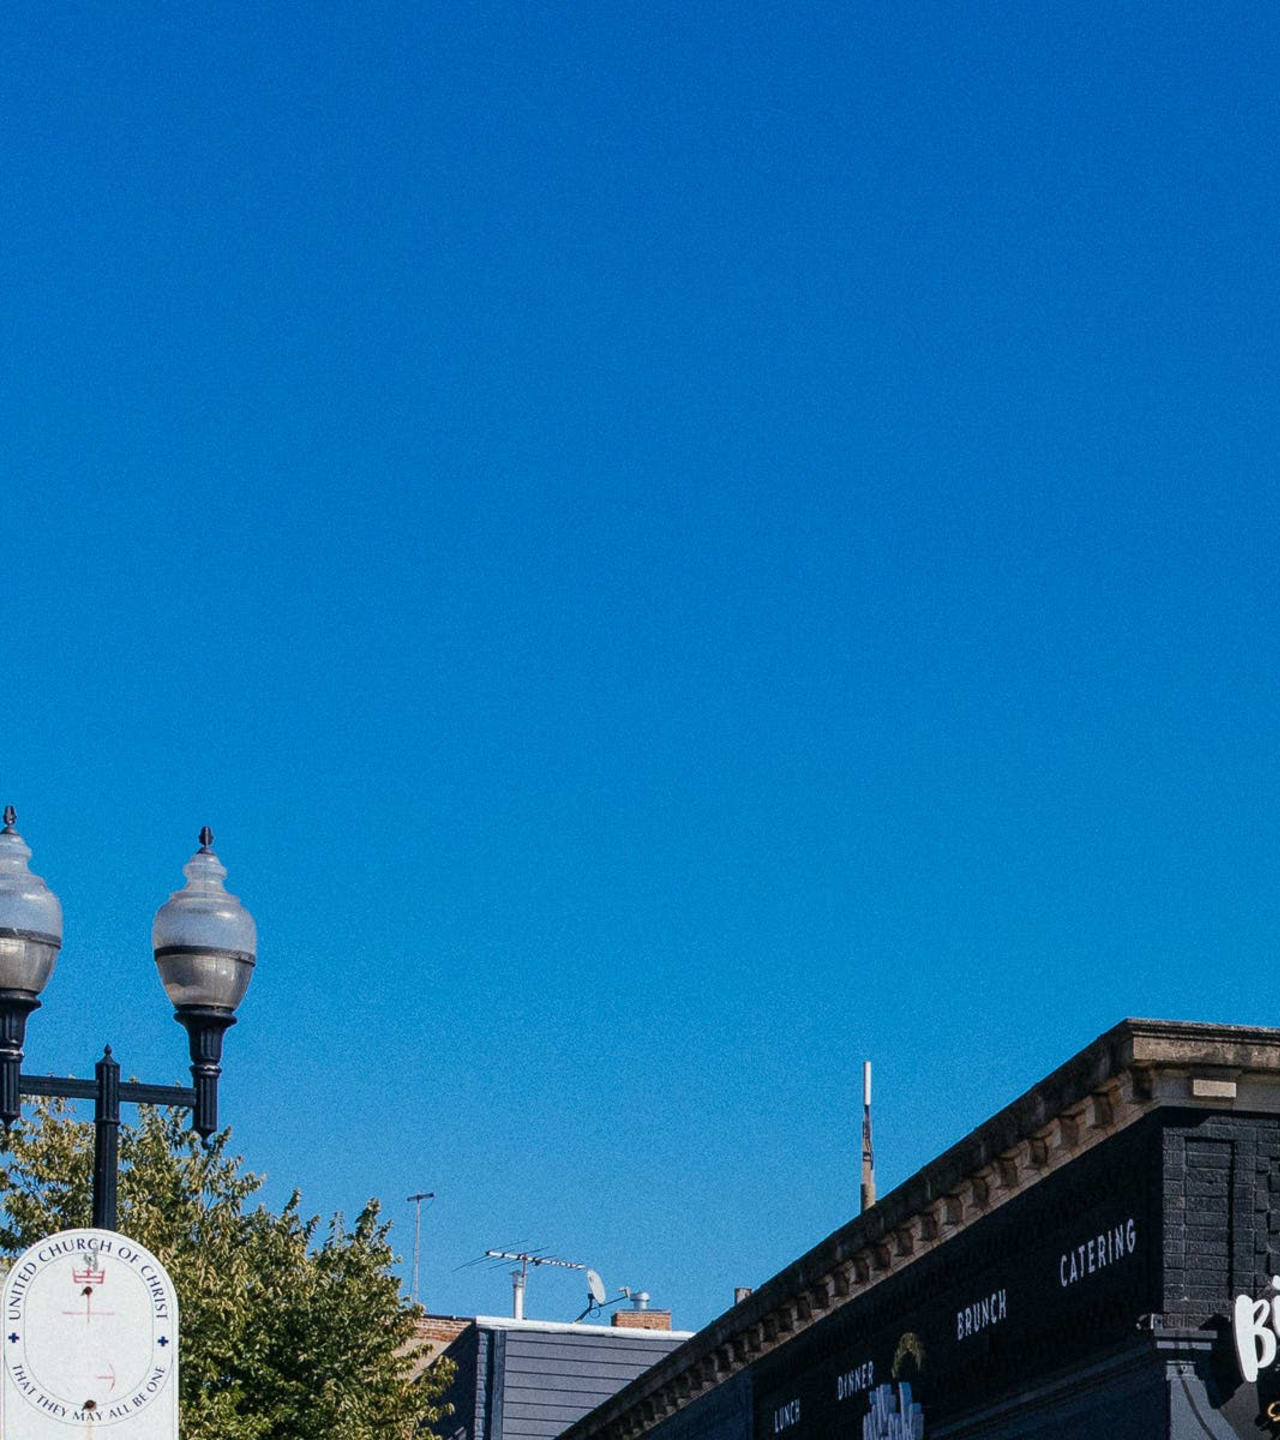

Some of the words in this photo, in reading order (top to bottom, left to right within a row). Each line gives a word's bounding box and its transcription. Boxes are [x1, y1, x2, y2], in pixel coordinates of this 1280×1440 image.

[8, 1261, 37, 1320] UNITED
[38, 1237, 113, 1262] CHURCH
[118, 1246, 141, 1264] OF
[141, 1265, 169, 1320] CHRIST
[1059, 1218, 1137, 1288] CATERING
[956, 1289, 1007, 1341] BRUNCH
[12, 1363, 39, 1396] THAT
[35, 1394, 69, 1418] THEY
[72, 1411, 105, 1422] MAY
[109, 1404, 133, 1419] ALL
[132, 1391, 150, 1407] BE
[148, 1366, 167, 1393] ONE
[837, 1360, 875, 1401] DINNER
[773, 1398, 801, 1434] LUNCH
